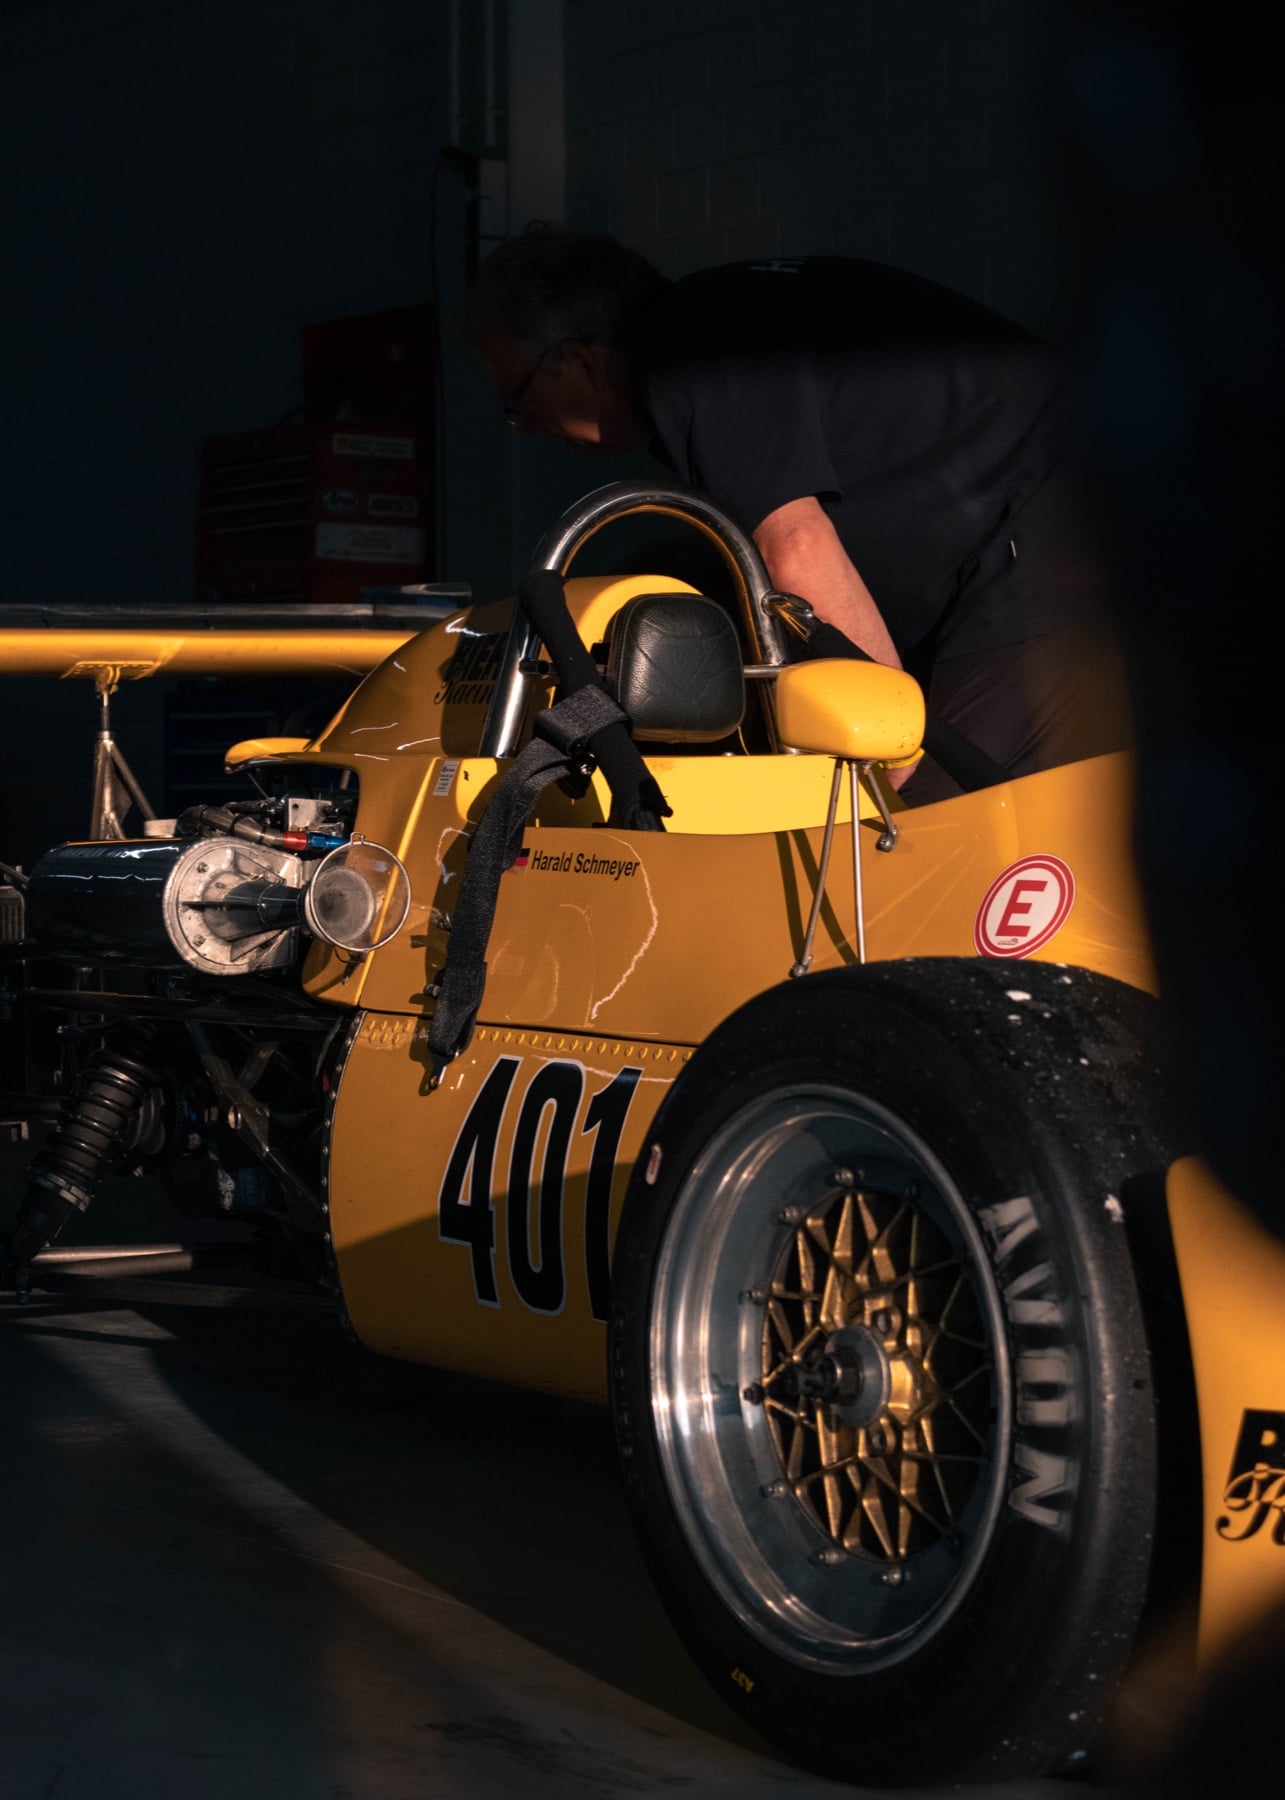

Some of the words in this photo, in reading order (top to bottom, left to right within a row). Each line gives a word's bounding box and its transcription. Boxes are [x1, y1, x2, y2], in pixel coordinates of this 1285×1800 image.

[531, 850, 574, 872] Harald
[574, 853, 640, 881] Schmeyer
[995, 879, 1048, 937] E
[438, 1055, 645, 1322] 401
[977, 1196, 1079, 1534] AVON
